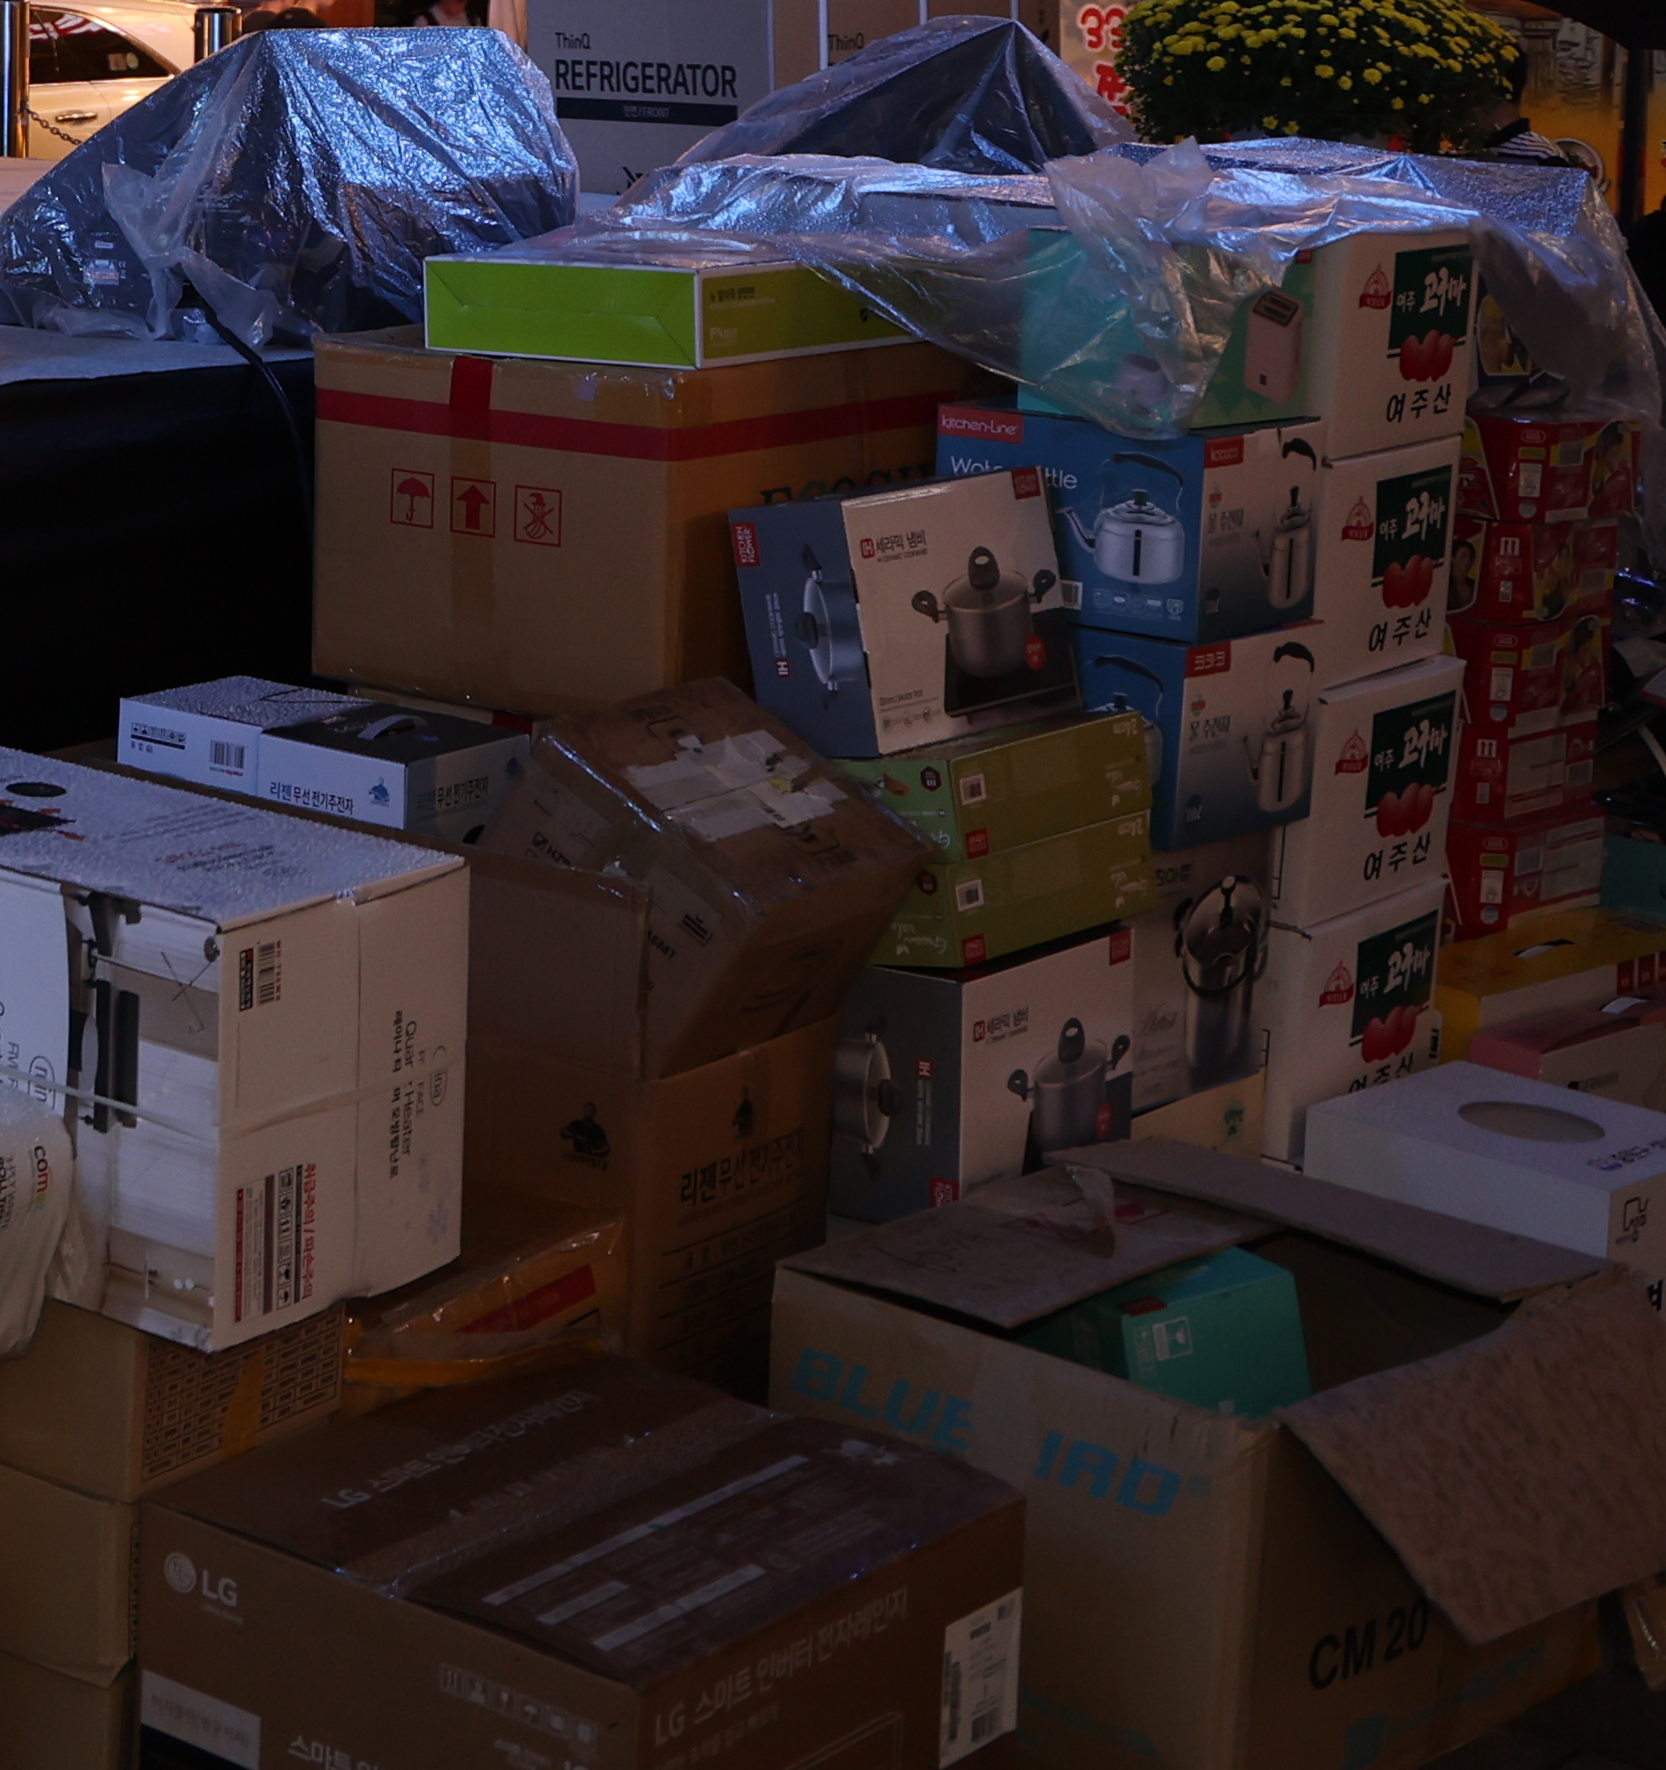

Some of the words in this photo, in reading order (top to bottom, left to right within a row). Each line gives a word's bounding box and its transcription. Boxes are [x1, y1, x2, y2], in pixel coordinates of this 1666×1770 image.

[554, 31, 592, 51] ThinQ
[554, 58, 738, 99] REFRIGERATOR
[1386, 383, 1452, 424] 여주산
[1369, 607, 1432, 653] 여주산
[1364, 832, 1431, 881] 여주산
[401, 1090, 416, 1157] Heater
[789, 1347, 974, 1455] BLUE
[1033, 1429, 1182, 1518] IRD
[201, 1569, 238, 1607] LG
[1307, 1629, 1377, 1691] CM
[654, 1702, 686, 1748] LG
[693, 1665, 753, 1726] 스마트
[755, 1634, 814, 1694] 인버터
